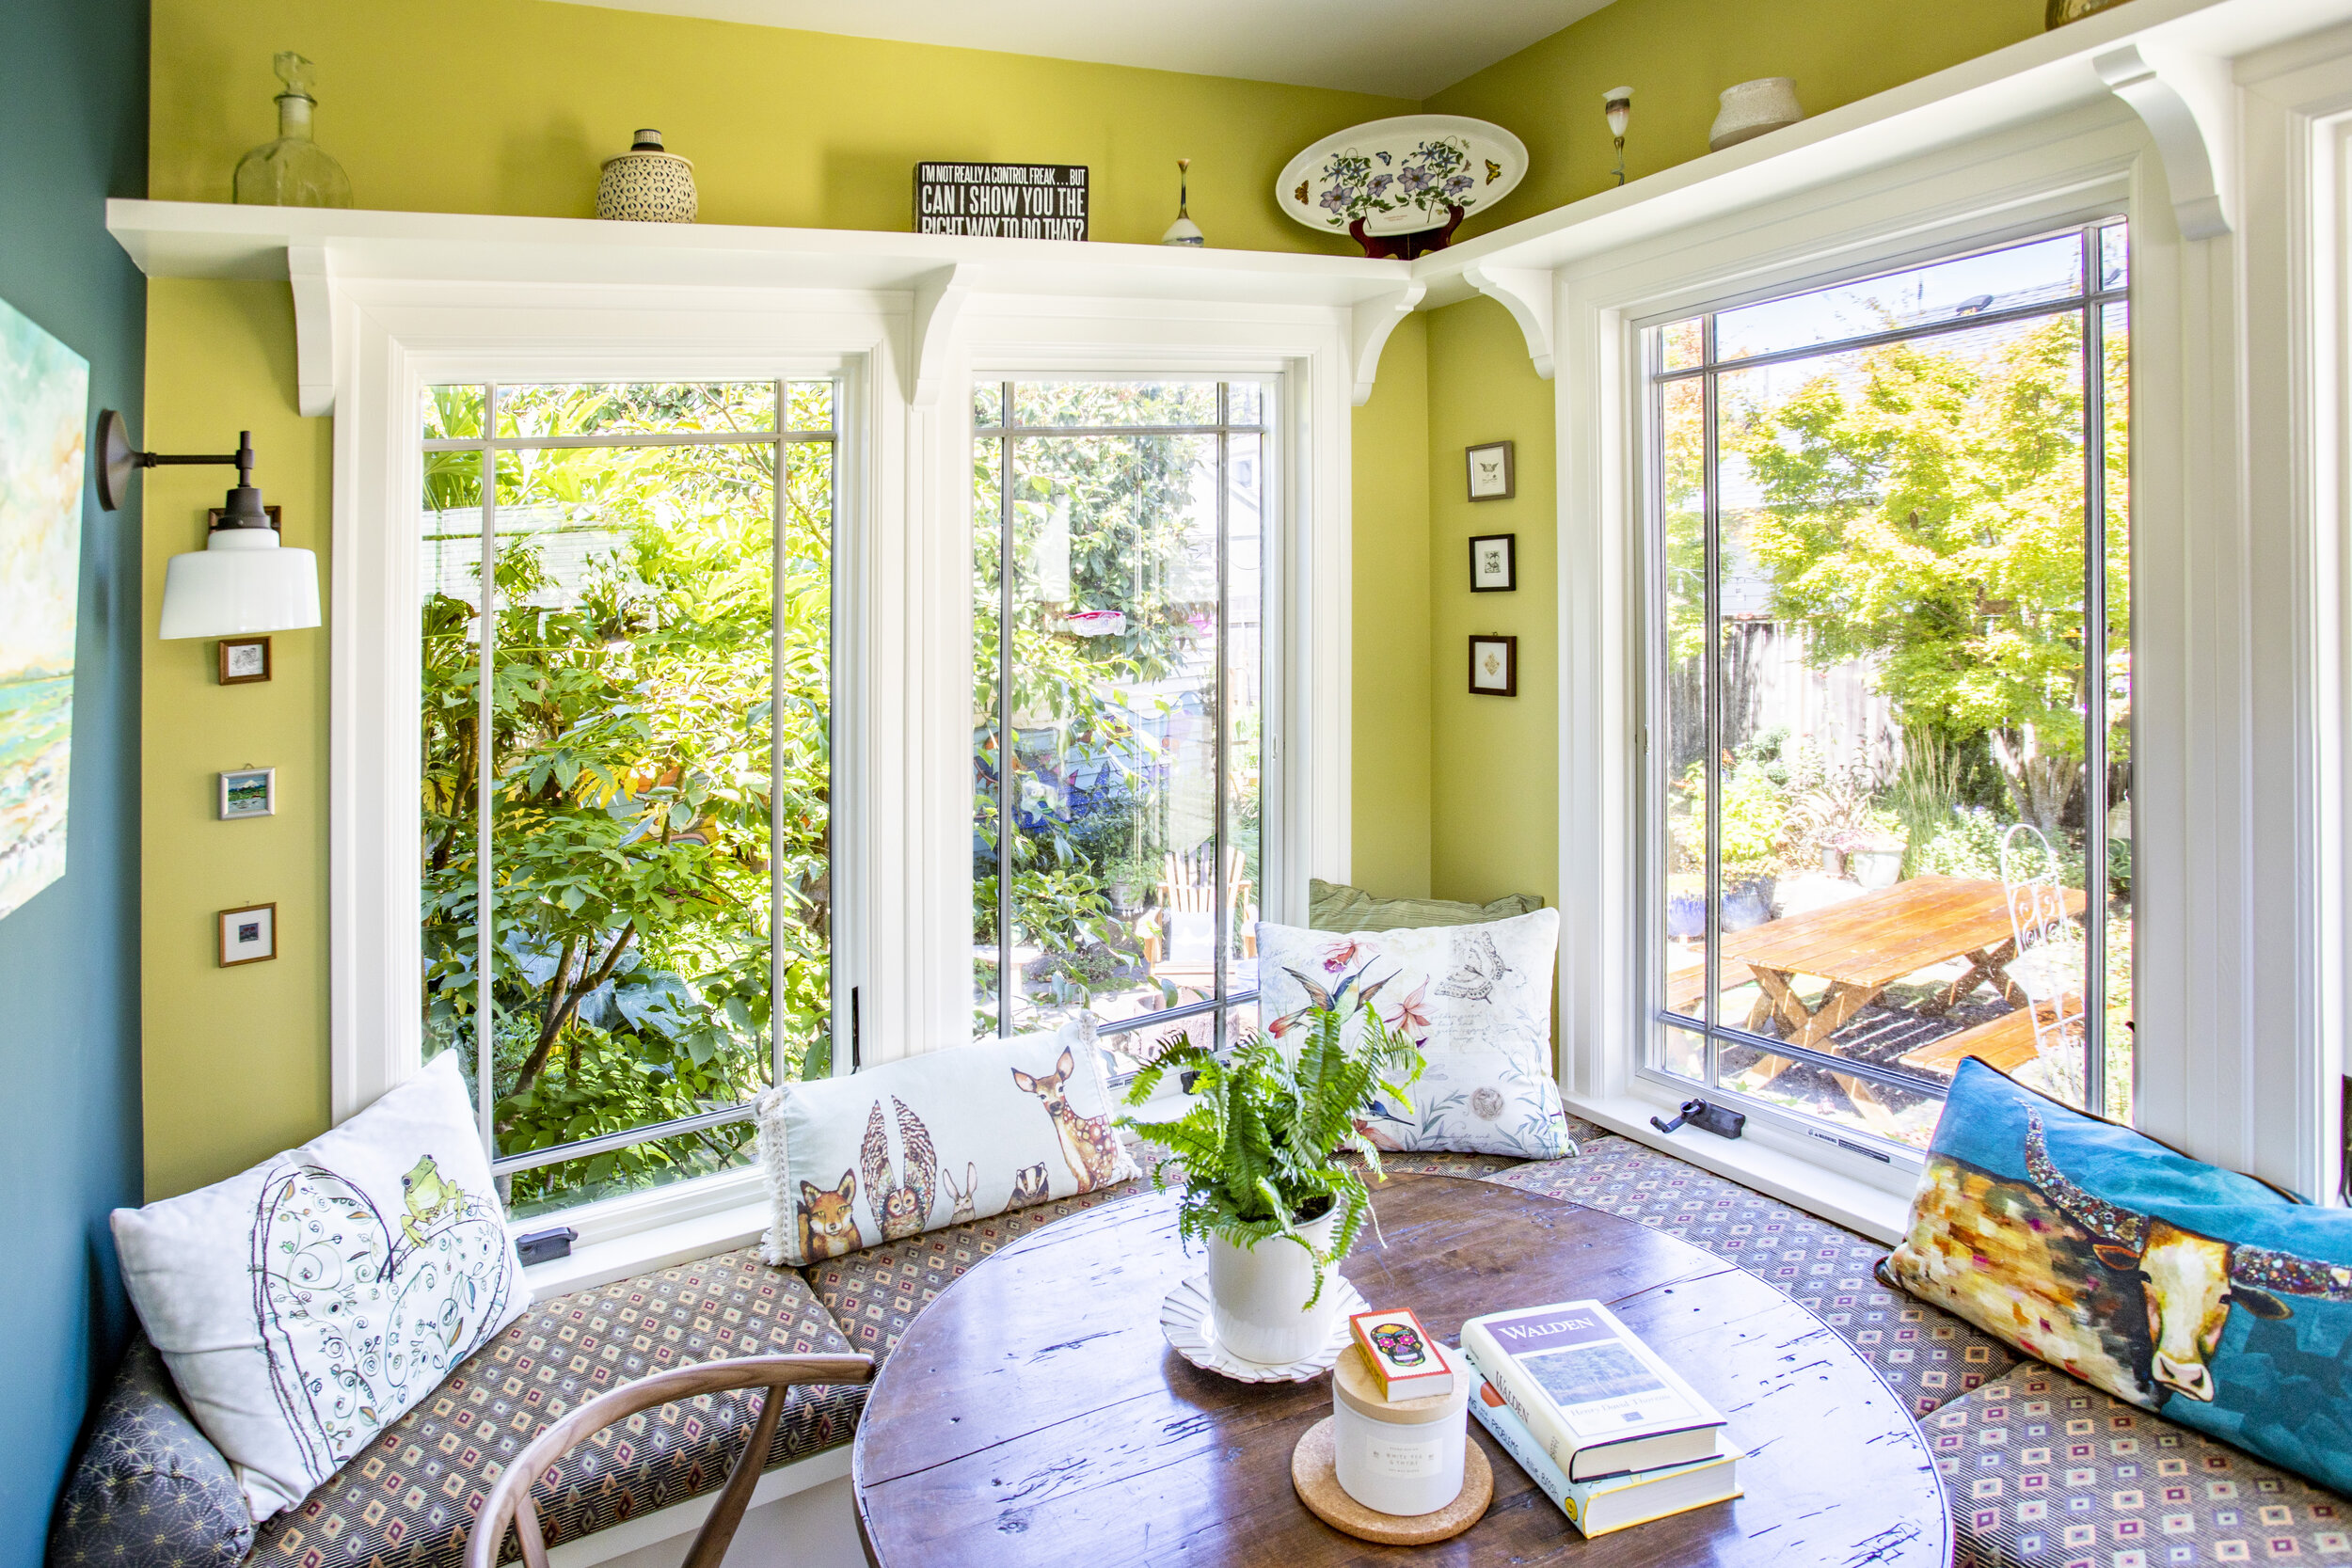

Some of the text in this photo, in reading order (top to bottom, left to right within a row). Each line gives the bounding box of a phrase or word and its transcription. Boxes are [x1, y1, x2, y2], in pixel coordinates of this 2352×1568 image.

[922, 165, 936, 182] I'M
[936, 166, 954, 183] NOT
[954, 166, 984, 183] REALLY
[984, 166, 991, 183] A
[991, 166, 1029, 184] CONTROL
[1070, 169, 1085, 186] BUT
[922, 185, 1085, 216] CAN I SHOW YOU THE
[922, 216, 1085, 241] RIGHT WAY TO DO THAT?
[1498, 1317, 1596, 1340] WALDEN
[1495, 1370, 1530, 1425] WALDEN
[1491, 1418, 1519, 1456] PROBLEMS
